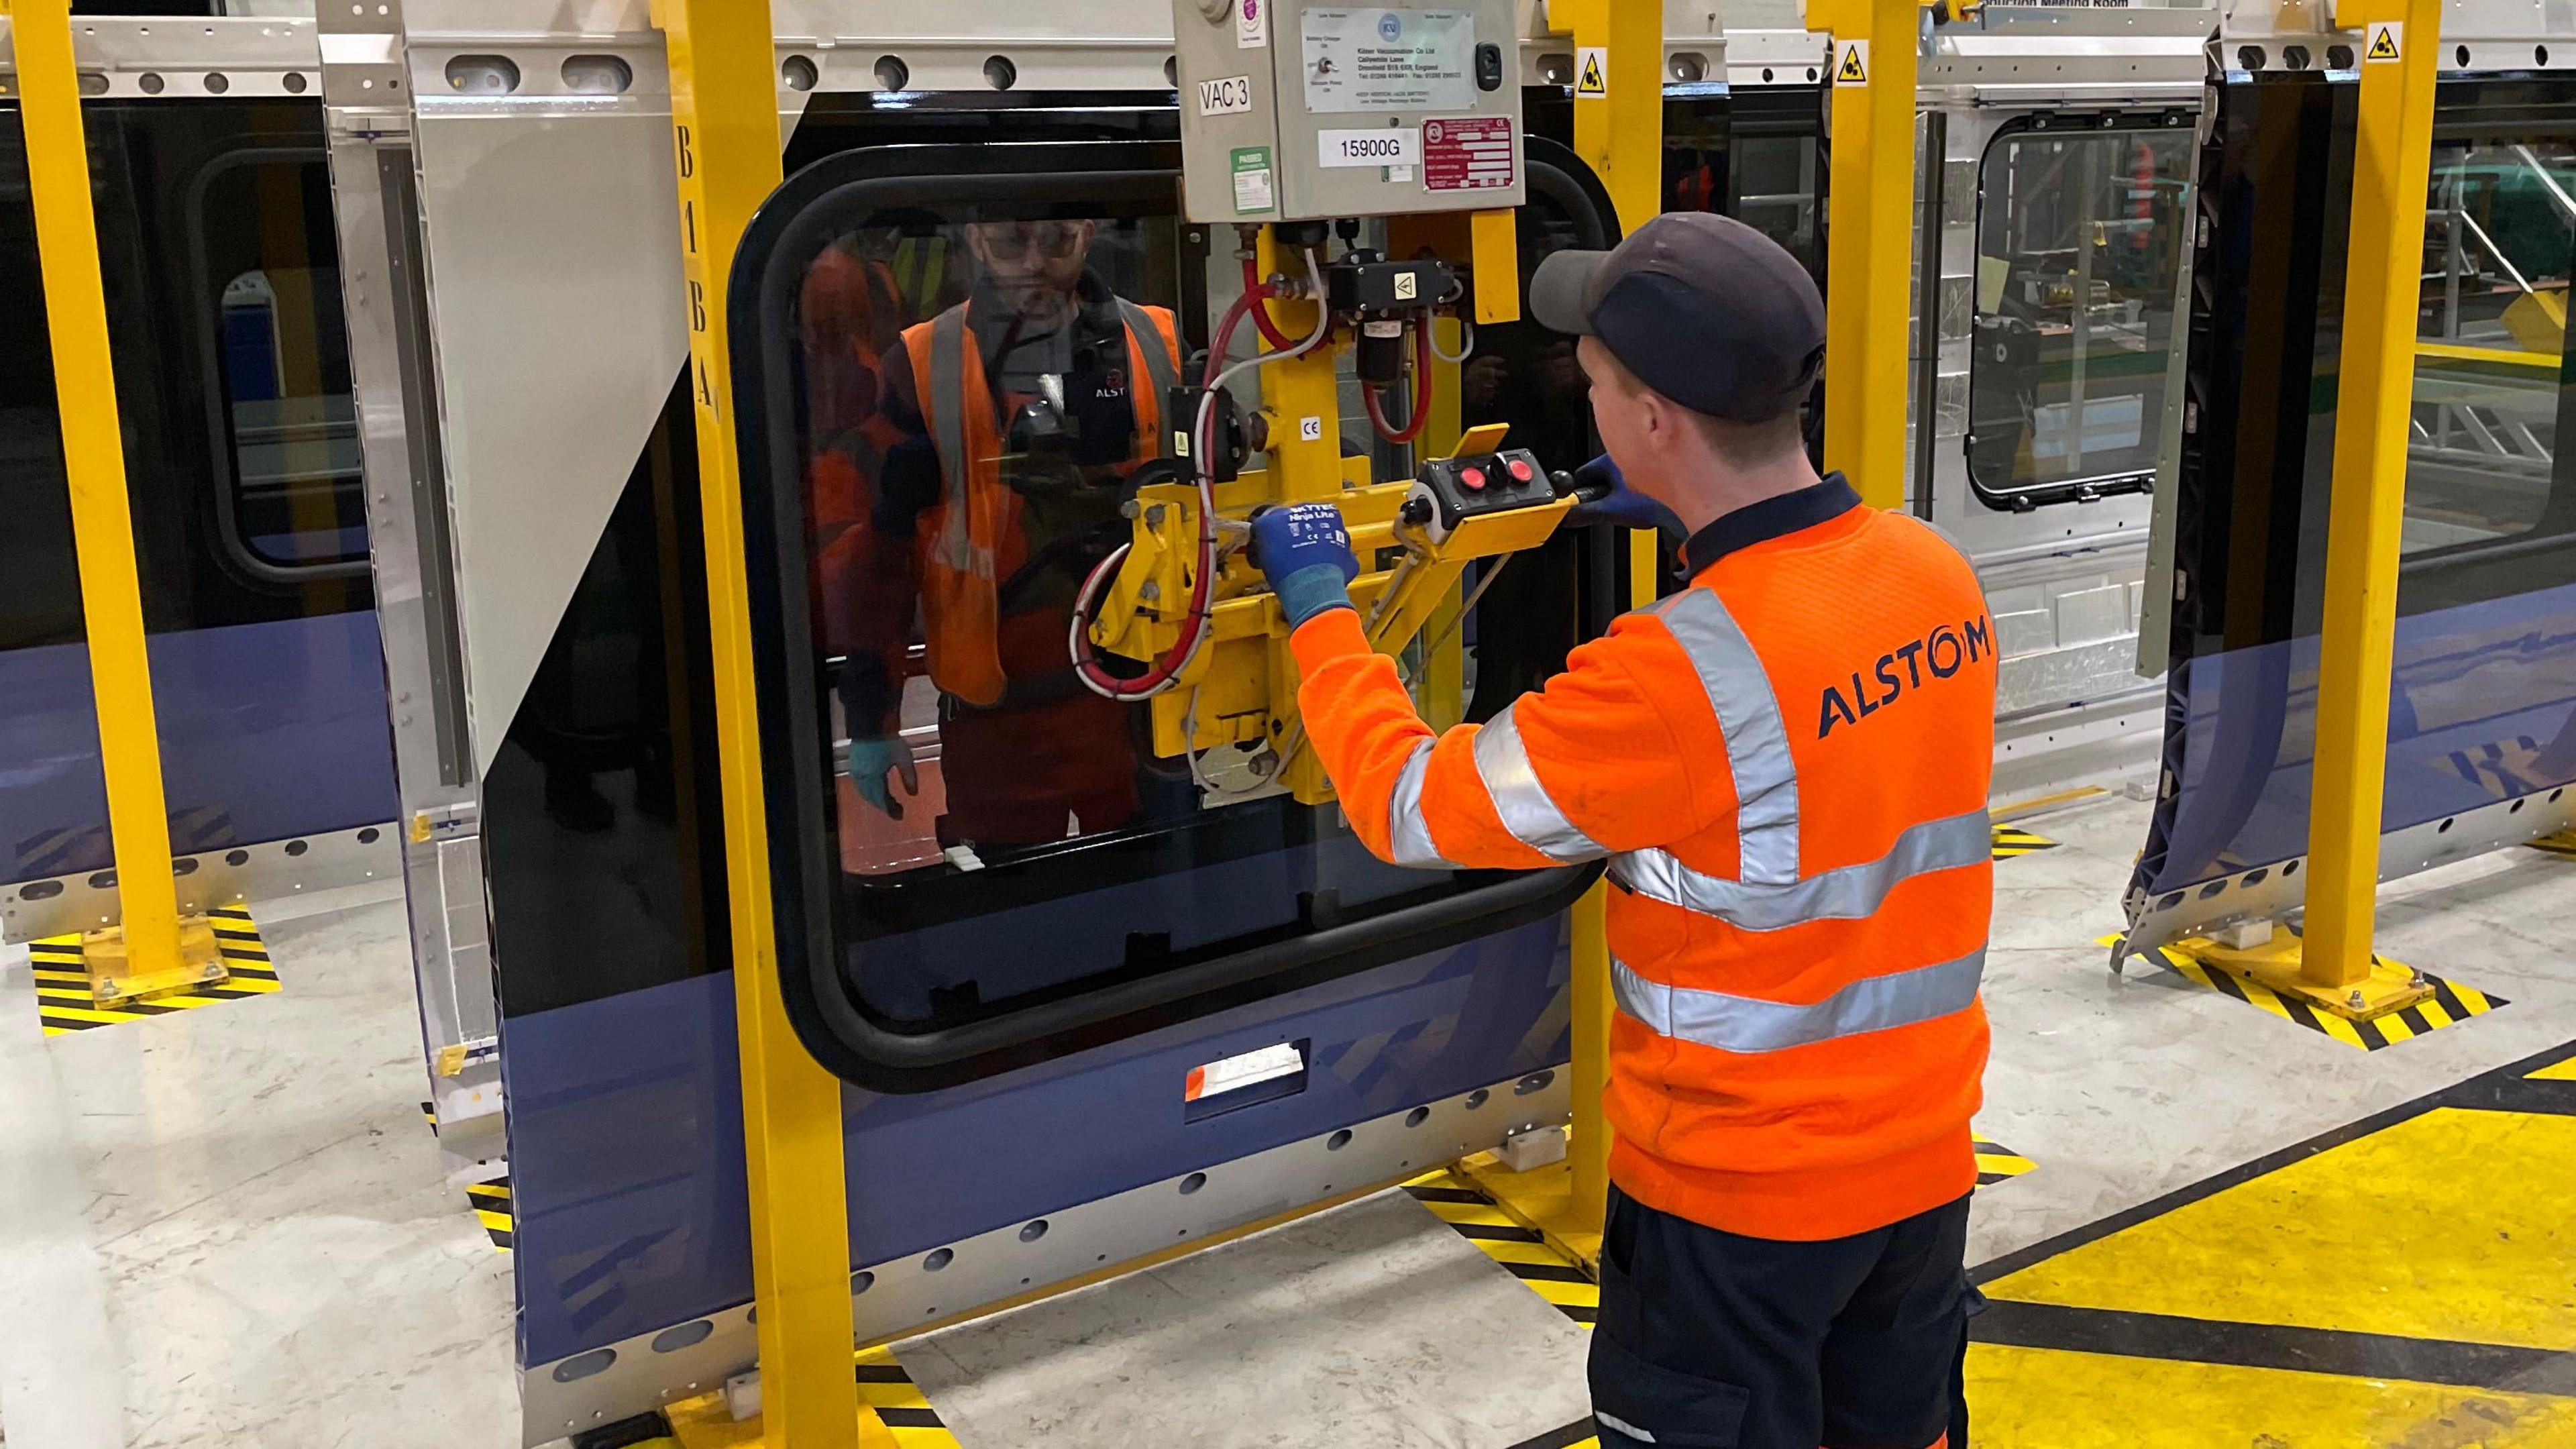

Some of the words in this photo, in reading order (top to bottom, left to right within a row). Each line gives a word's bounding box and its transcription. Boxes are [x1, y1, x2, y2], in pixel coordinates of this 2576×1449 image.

[1200, 81, 1234, 109] VAC
[1238, 79, 1248, 105] 3
[1342, 139, 1400, 156] 15900G
[1096, 387, 1125, 397] ALST
[1303, 420, 1318, 435] CE
[1289, 512, 1314, 521] Ninja
[1818, 614, 1991, 740] ALSTOM
